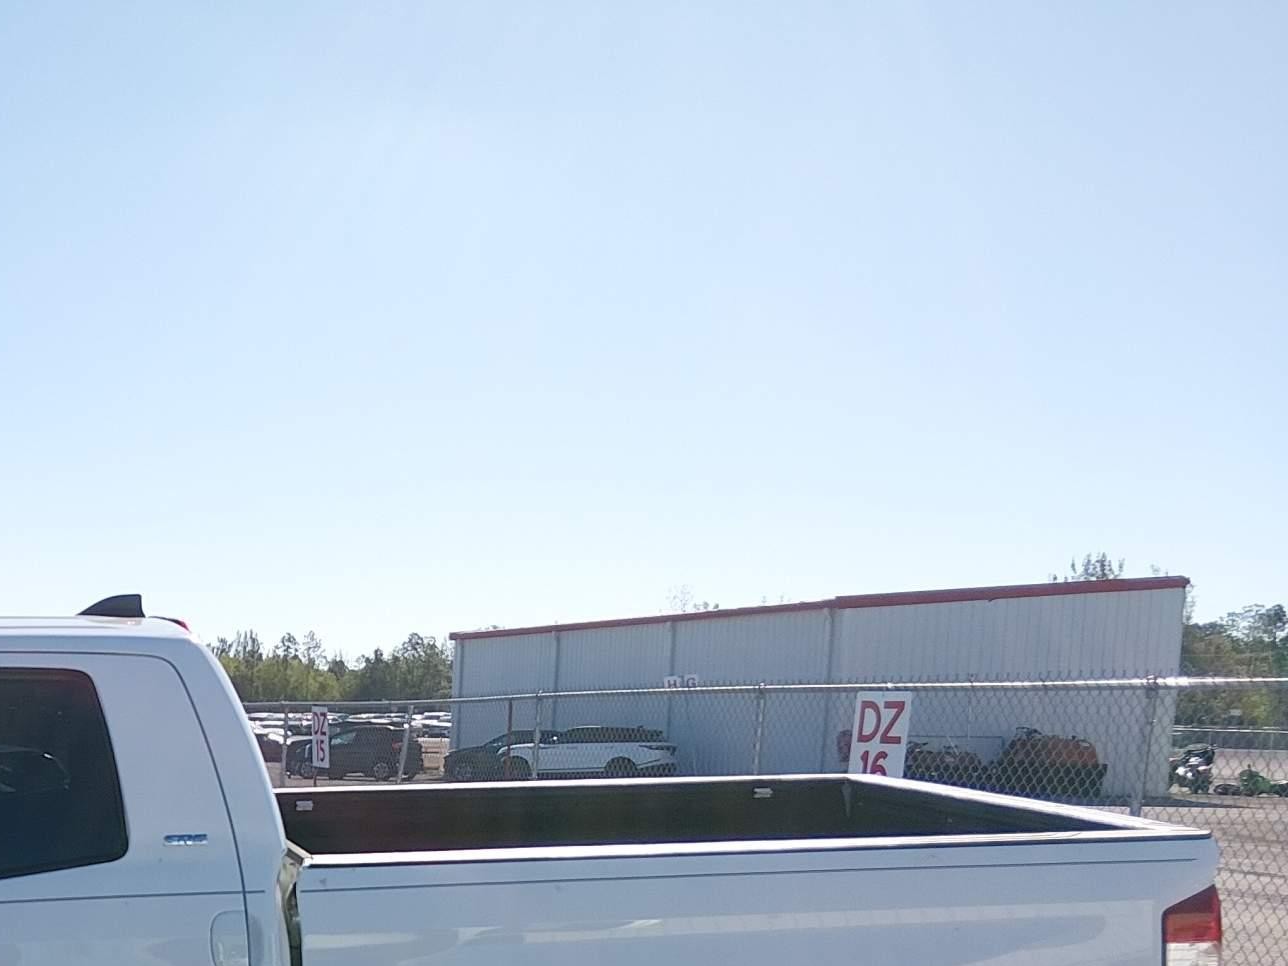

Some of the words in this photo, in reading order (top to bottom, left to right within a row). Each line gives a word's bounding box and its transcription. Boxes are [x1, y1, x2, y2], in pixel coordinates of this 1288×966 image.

[312, 711, 328, 736] DZ
[856, 700, 906, 745] DZ
[315, 739, 326, 762] 15
[860, 750, 888, 776] 16
